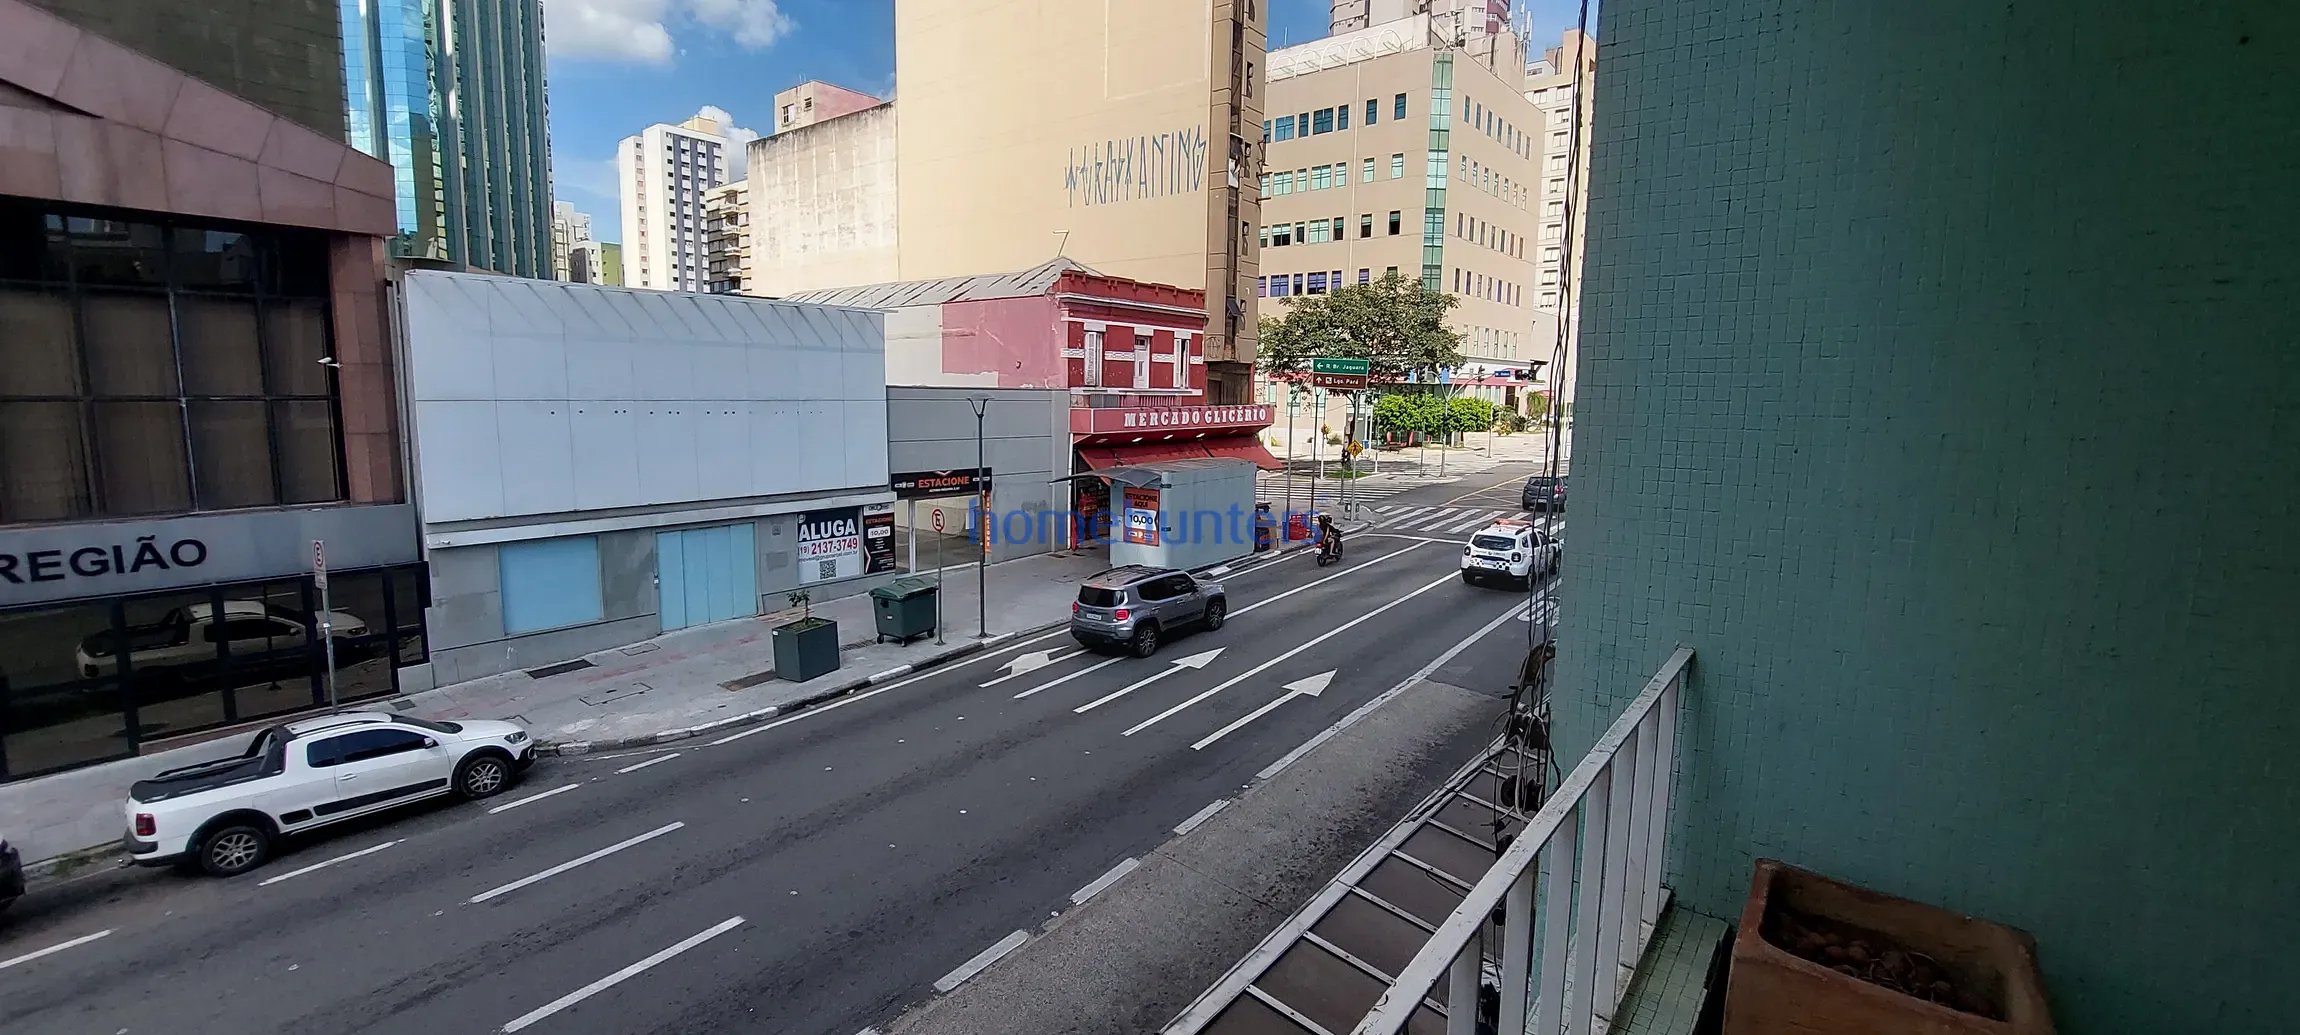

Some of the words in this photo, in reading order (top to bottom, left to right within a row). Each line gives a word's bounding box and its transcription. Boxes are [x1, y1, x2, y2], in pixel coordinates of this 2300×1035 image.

[1124, 411, 1200, 428] MERCADO
[1204, 405, 1266, 424] GLICÉRIO
[918, 476, 969, 488] ESTACIONE
[1129, 514, 1154, 525] 10,00
[798, 518, 856, 542] ALUGA
[870, 528, 889, 536] 10,00
[798, 545, 810, 556] (19)
[811, 537, 858, 555] 2137-3749
[0, 534, 207, 584] REGIÃO
